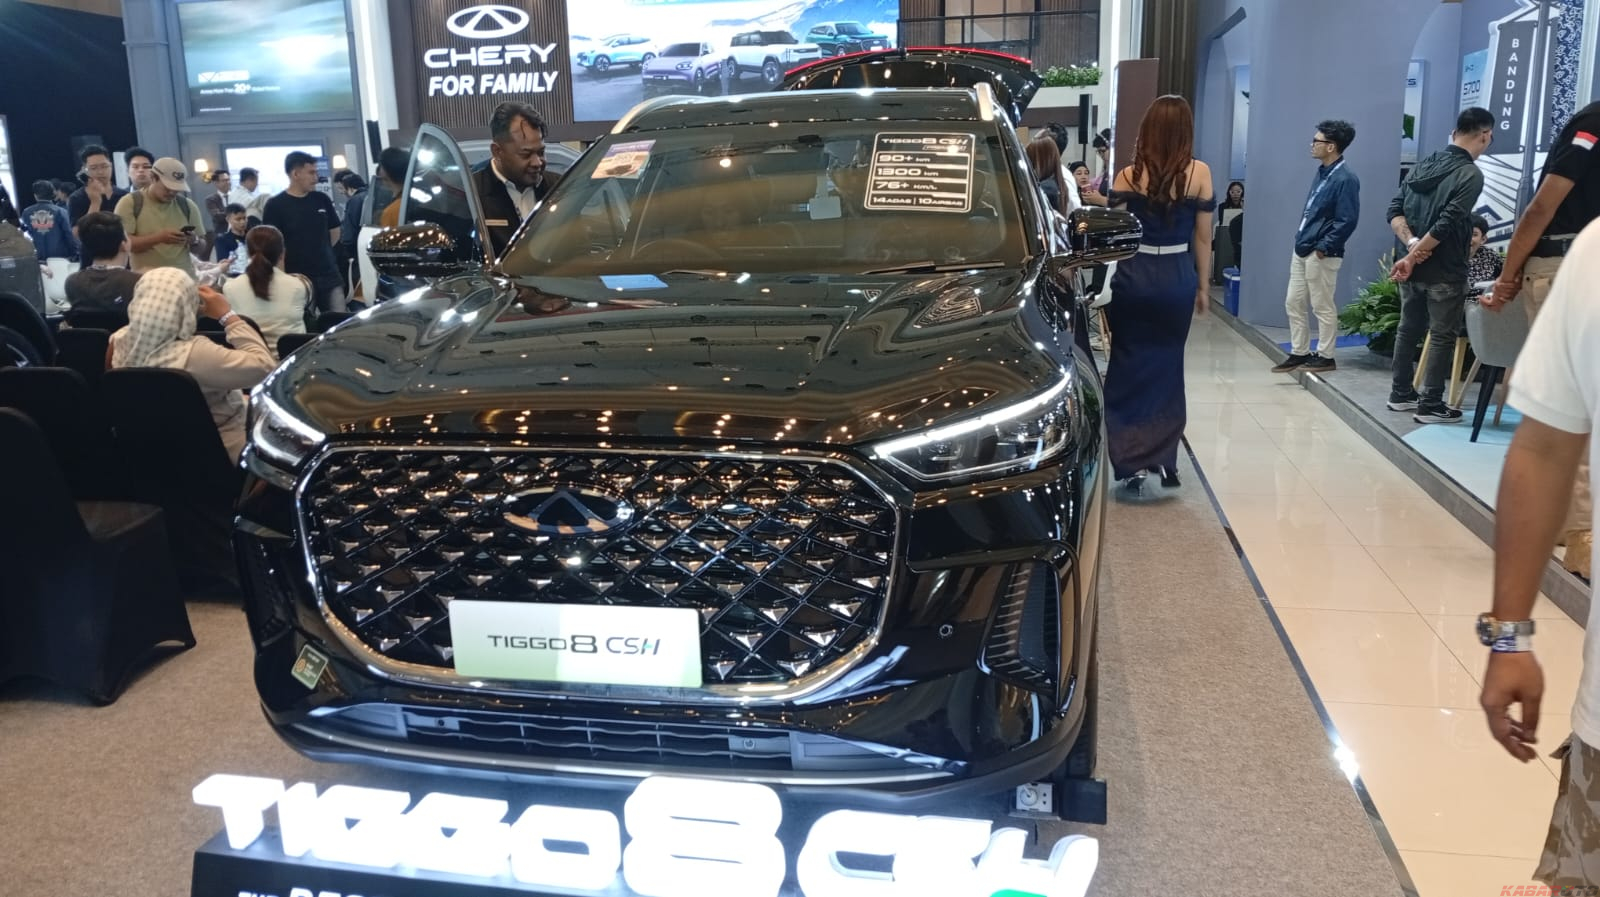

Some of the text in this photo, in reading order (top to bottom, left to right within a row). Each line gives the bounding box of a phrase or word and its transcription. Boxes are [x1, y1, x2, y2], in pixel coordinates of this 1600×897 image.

[424, 43, 558, 69] CHERY
[428, 71, 559, 97] FOR FAMILY
[1500, 38, 1520, 130] BANDUNG
[879, 154, 914, 162] 90+
[877, 168, 922, 176] 1300
[875, 181, 910, 189] 76+
[605, 636, 661, 655] CSH
